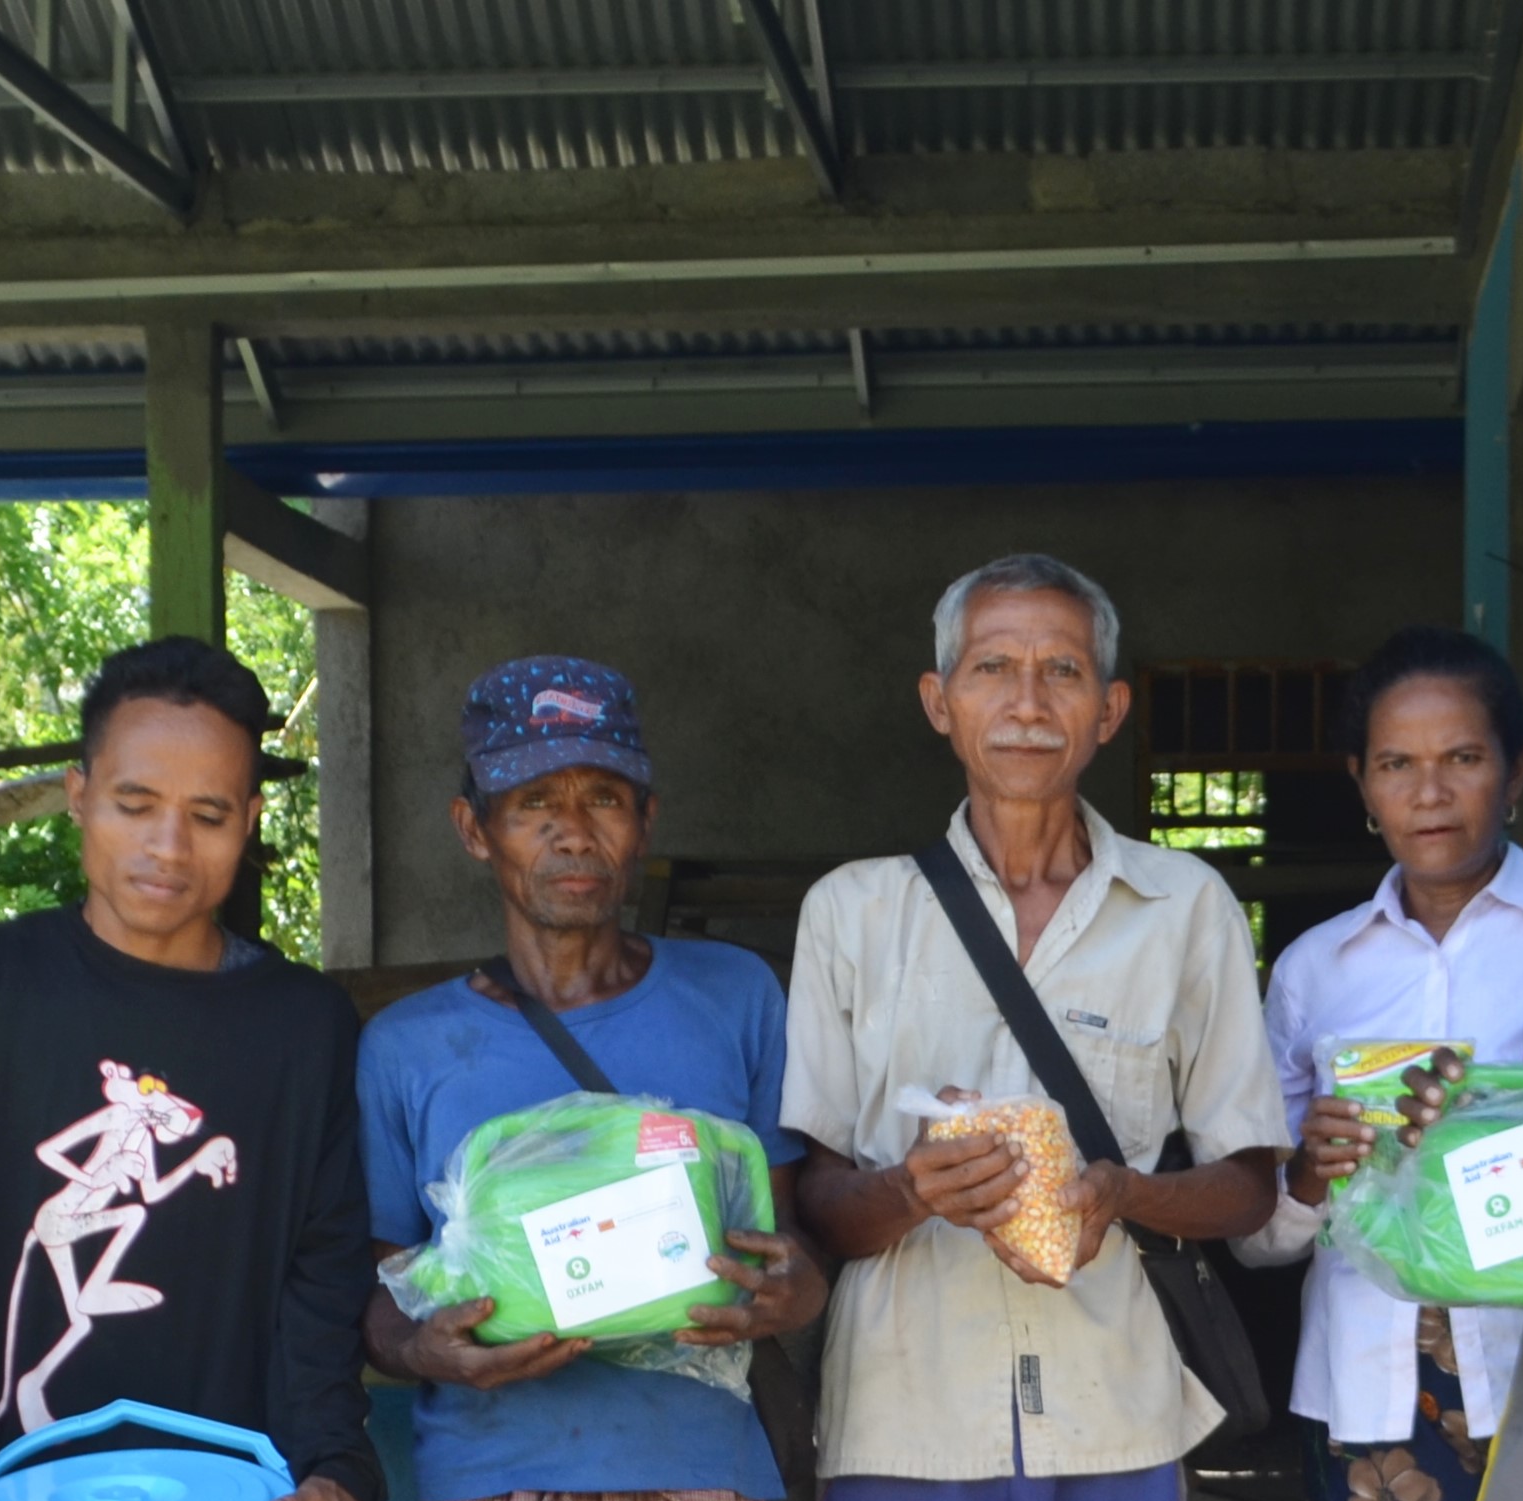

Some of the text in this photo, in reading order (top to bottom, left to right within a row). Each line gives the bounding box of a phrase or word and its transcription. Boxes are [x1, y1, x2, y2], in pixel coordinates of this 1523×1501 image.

[1461, 1151, 1514, 1175] Australian
[1463, 1173, 1482, 1185] Aid
[540, 1214, 592, 1238] Australian
[543, 1235, 562, 1248] Aid
[566, 1279, 605, 1300] OXFAM
